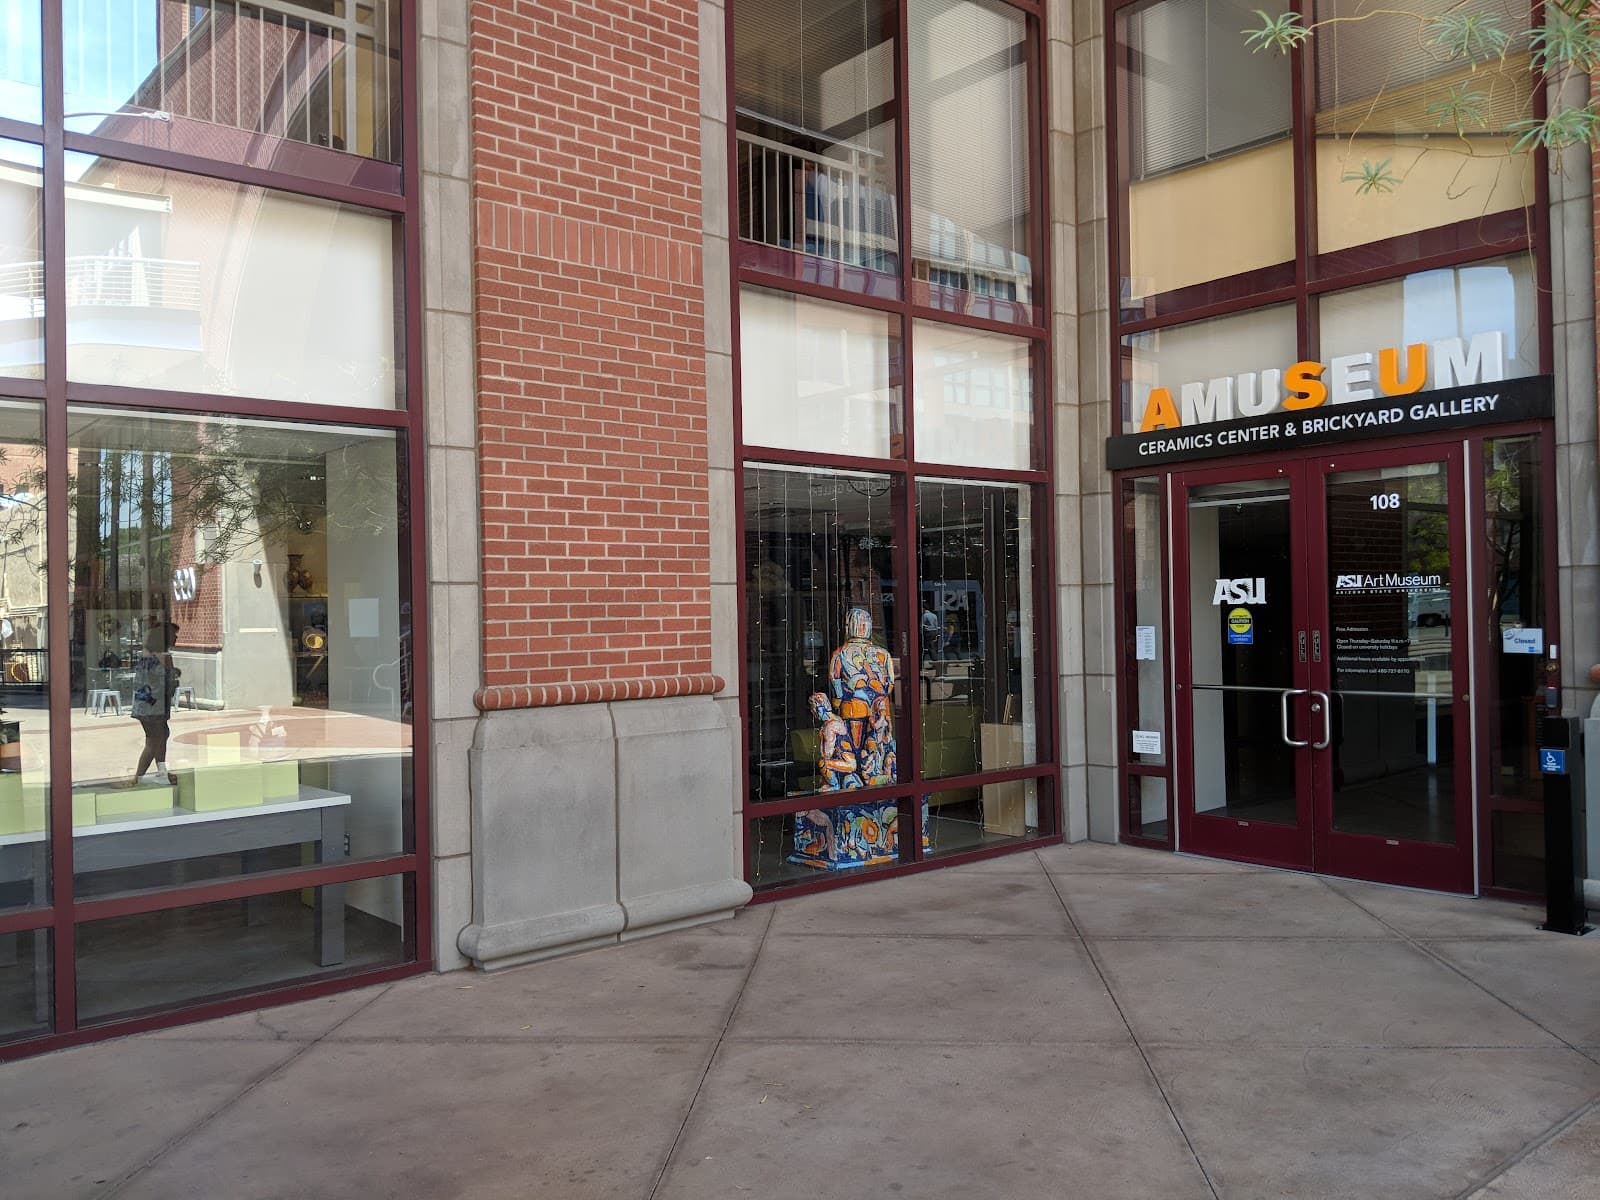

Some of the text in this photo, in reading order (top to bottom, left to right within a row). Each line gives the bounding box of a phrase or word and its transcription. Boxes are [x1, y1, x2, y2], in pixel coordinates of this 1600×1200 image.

[1140, 331, 1503, 432] AMUSEUM
[1138, 394, 1499, 456] CERAMICS CENTER & BRICKYARD GALLERY
[1369, 493, 1400, 510] 108
[1213, 577, 1267, 605] ASU
[1336, 573, 1440, 588] ASU Art Museum
